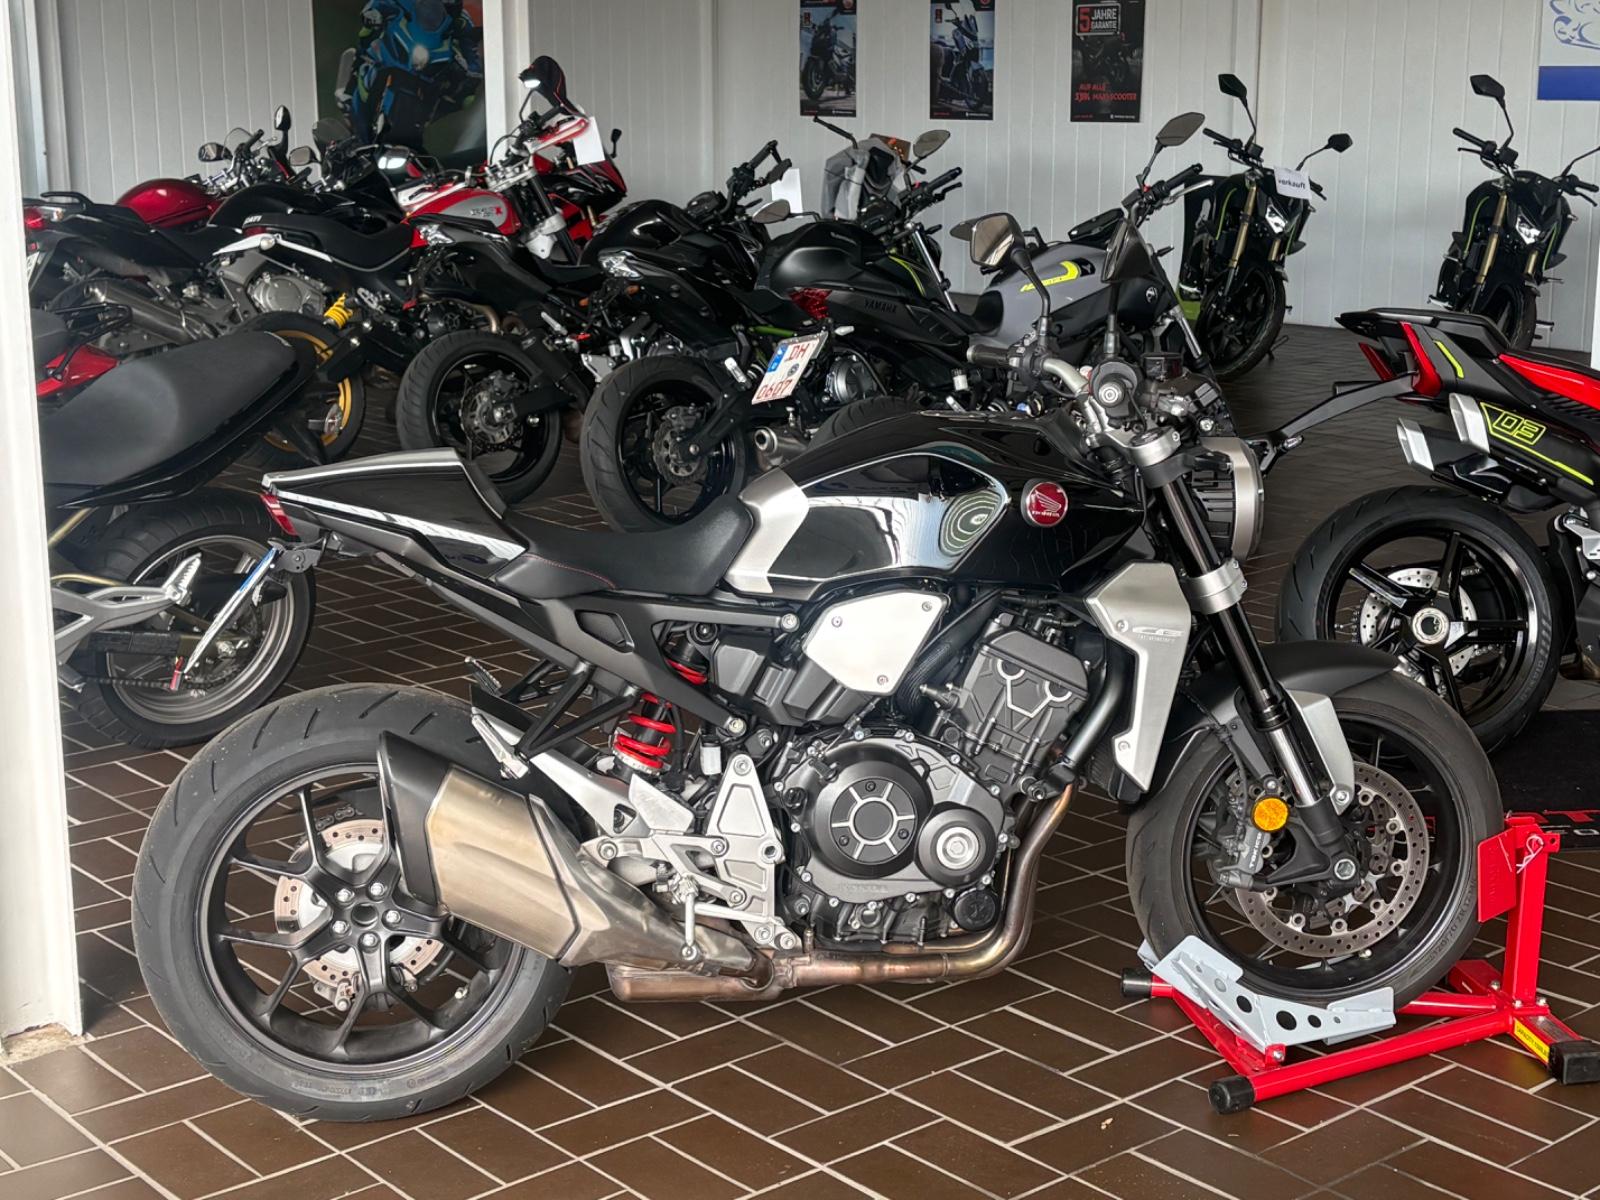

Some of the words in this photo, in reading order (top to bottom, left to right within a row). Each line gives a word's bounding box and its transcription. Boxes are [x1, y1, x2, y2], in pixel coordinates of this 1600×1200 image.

[1079, 8, 1092, 32] 5
[1091, 9, 1118, 20] JAHRE
[1090, 20, 1118, 29] GARANTIE
[1278, 179, 1306, 190] verkauft
[864, 297, 898, 313] YAMAHA
[1031, 510, 1060, 518] HONDA
